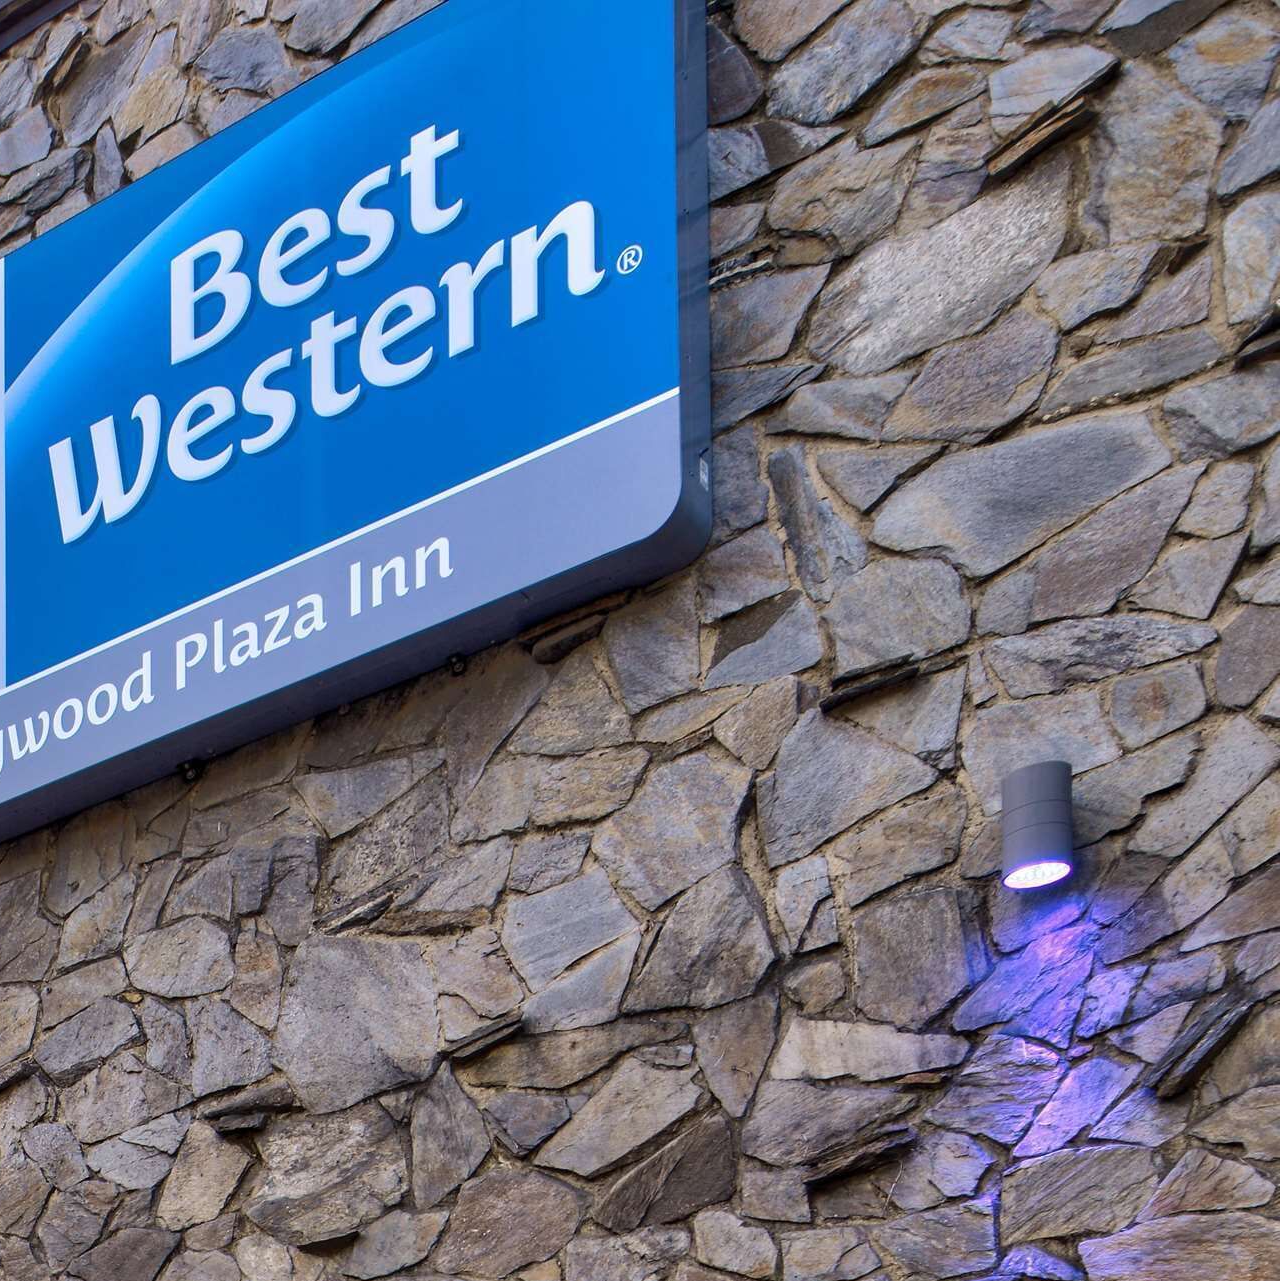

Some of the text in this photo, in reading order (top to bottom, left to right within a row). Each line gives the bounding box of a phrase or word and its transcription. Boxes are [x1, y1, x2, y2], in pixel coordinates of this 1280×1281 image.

[170, 124, 465, 364] Best
[48, 201, 605, 544] Western
[174, 591, 327, 689] Plaza
[351, 532, 454, 617] Inn
